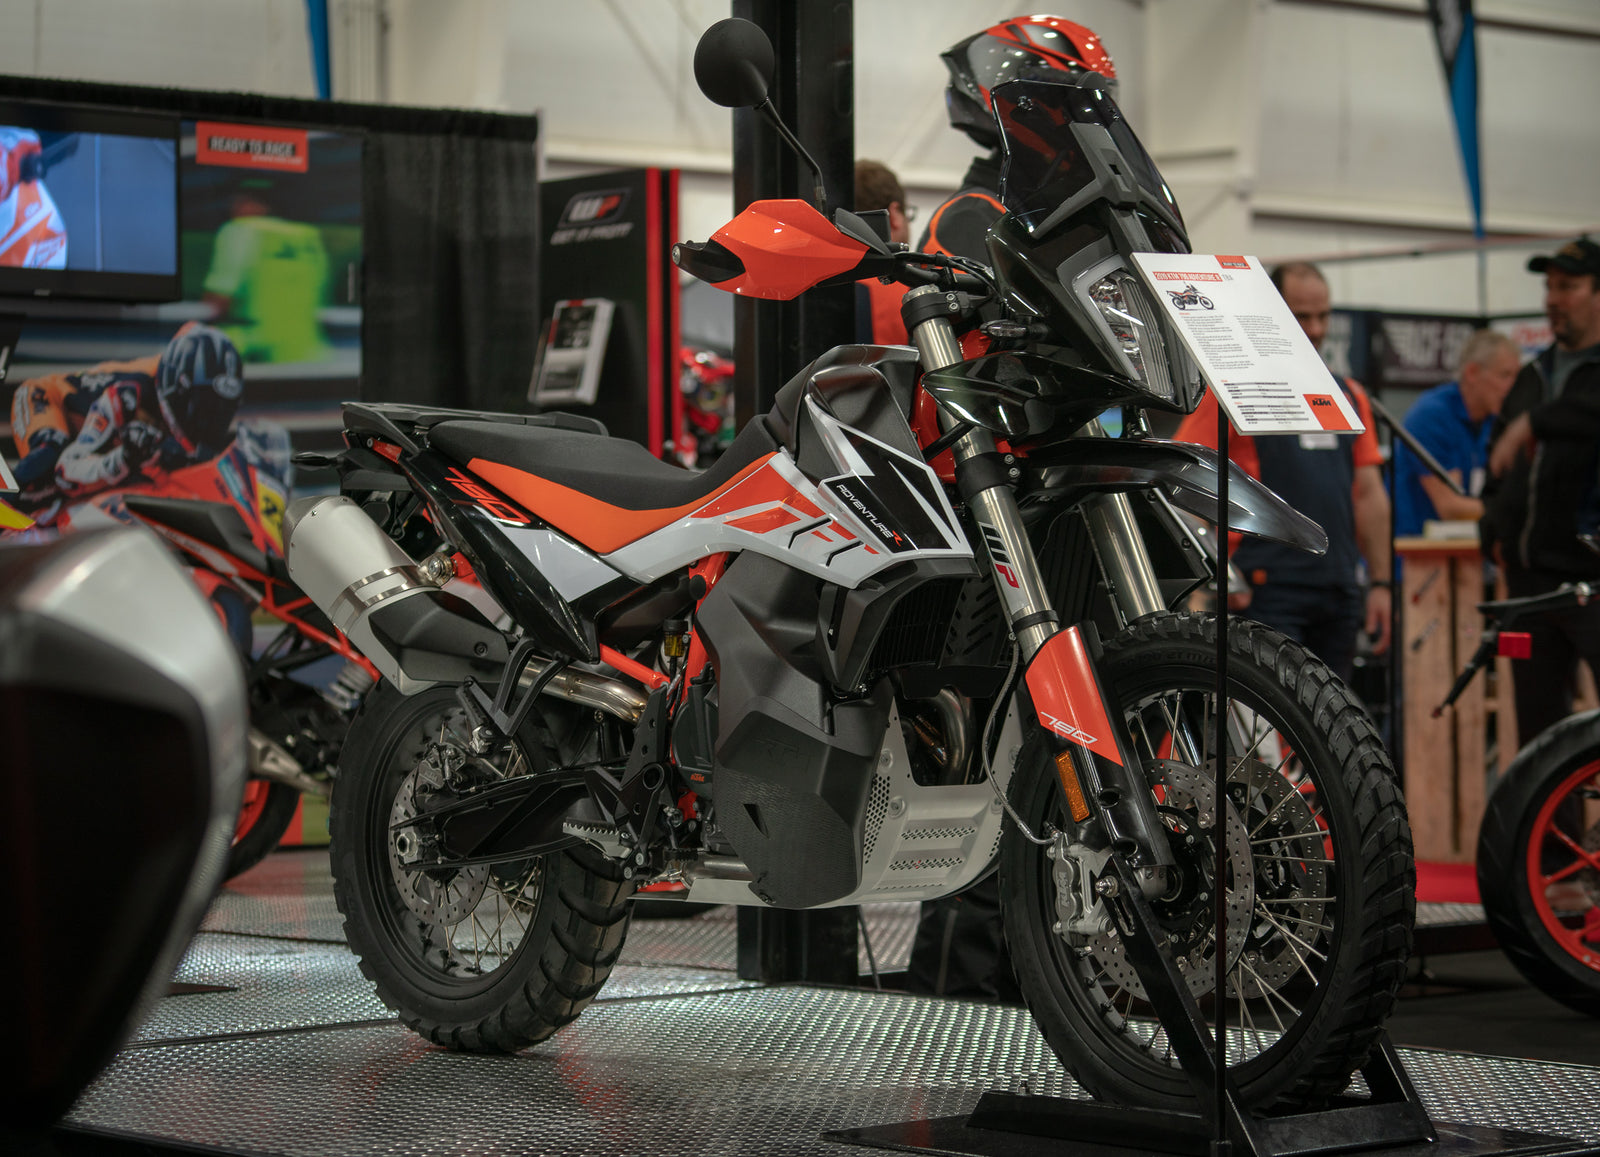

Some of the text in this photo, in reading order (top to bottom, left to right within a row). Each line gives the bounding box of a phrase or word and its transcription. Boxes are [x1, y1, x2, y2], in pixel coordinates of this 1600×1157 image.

[210, 136, 294, 157] READY TO RACE
[1312, 397, 1332, 407] KTM
[444, 467, 531, 523] 790
[836, 484, 903, 546] ADVENTURE R
[981, 526, 1020, 588] WP
[1040, 711, 1098, 744] 790
